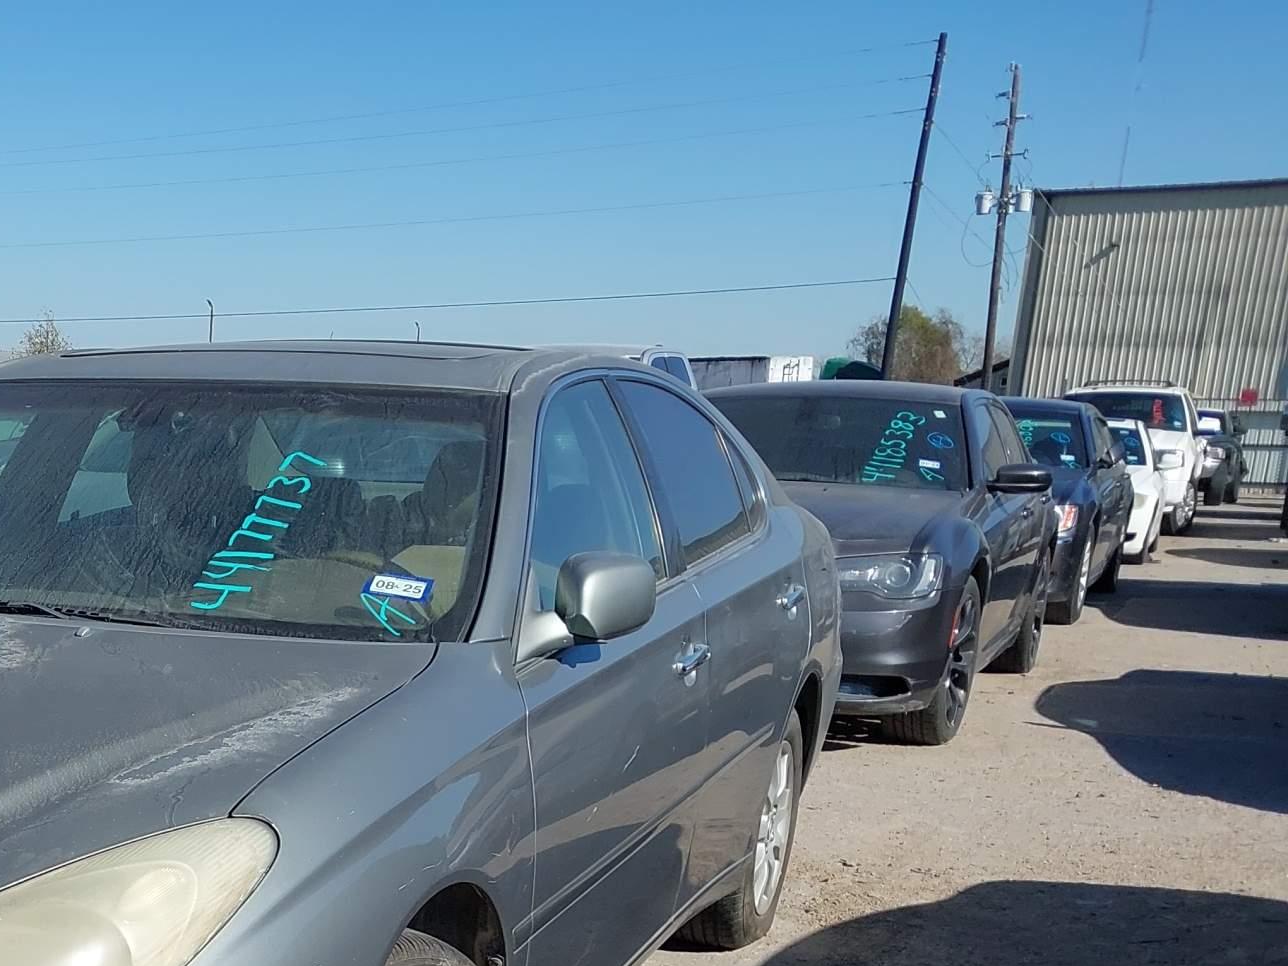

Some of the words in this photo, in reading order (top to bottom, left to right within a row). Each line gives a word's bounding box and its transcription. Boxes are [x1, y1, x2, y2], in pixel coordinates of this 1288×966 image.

[919, 467, 946, 481] A
[190, 450, 328, 610] 44177737
[360, 592, 417, 636] A
